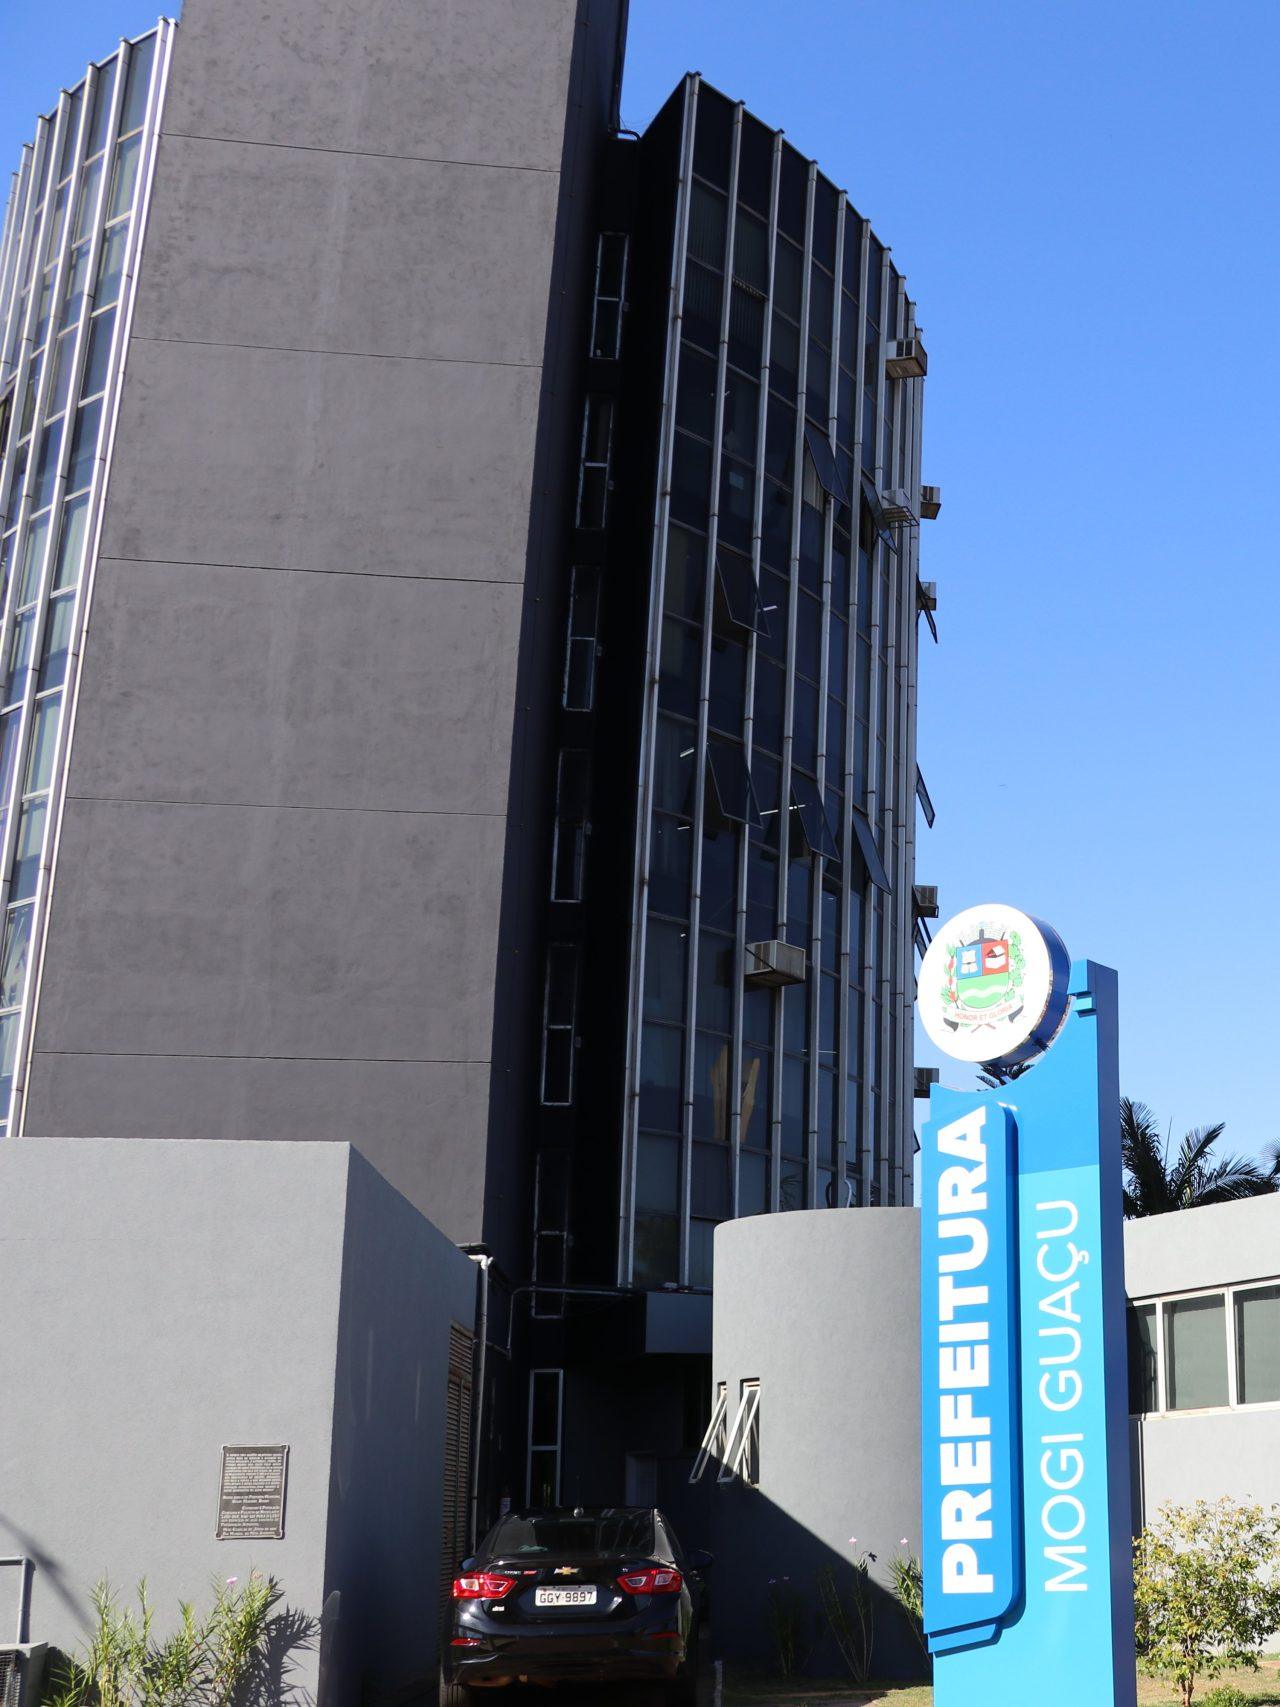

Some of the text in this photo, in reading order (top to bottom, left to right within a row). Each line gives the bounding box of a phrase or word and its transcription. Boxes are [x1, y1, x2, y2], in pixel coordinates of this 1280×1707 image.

[938, 1105, 994, 1594] PREFEITURA
[1036, 1200, 1090, 1592] MOGI GUAÇU
